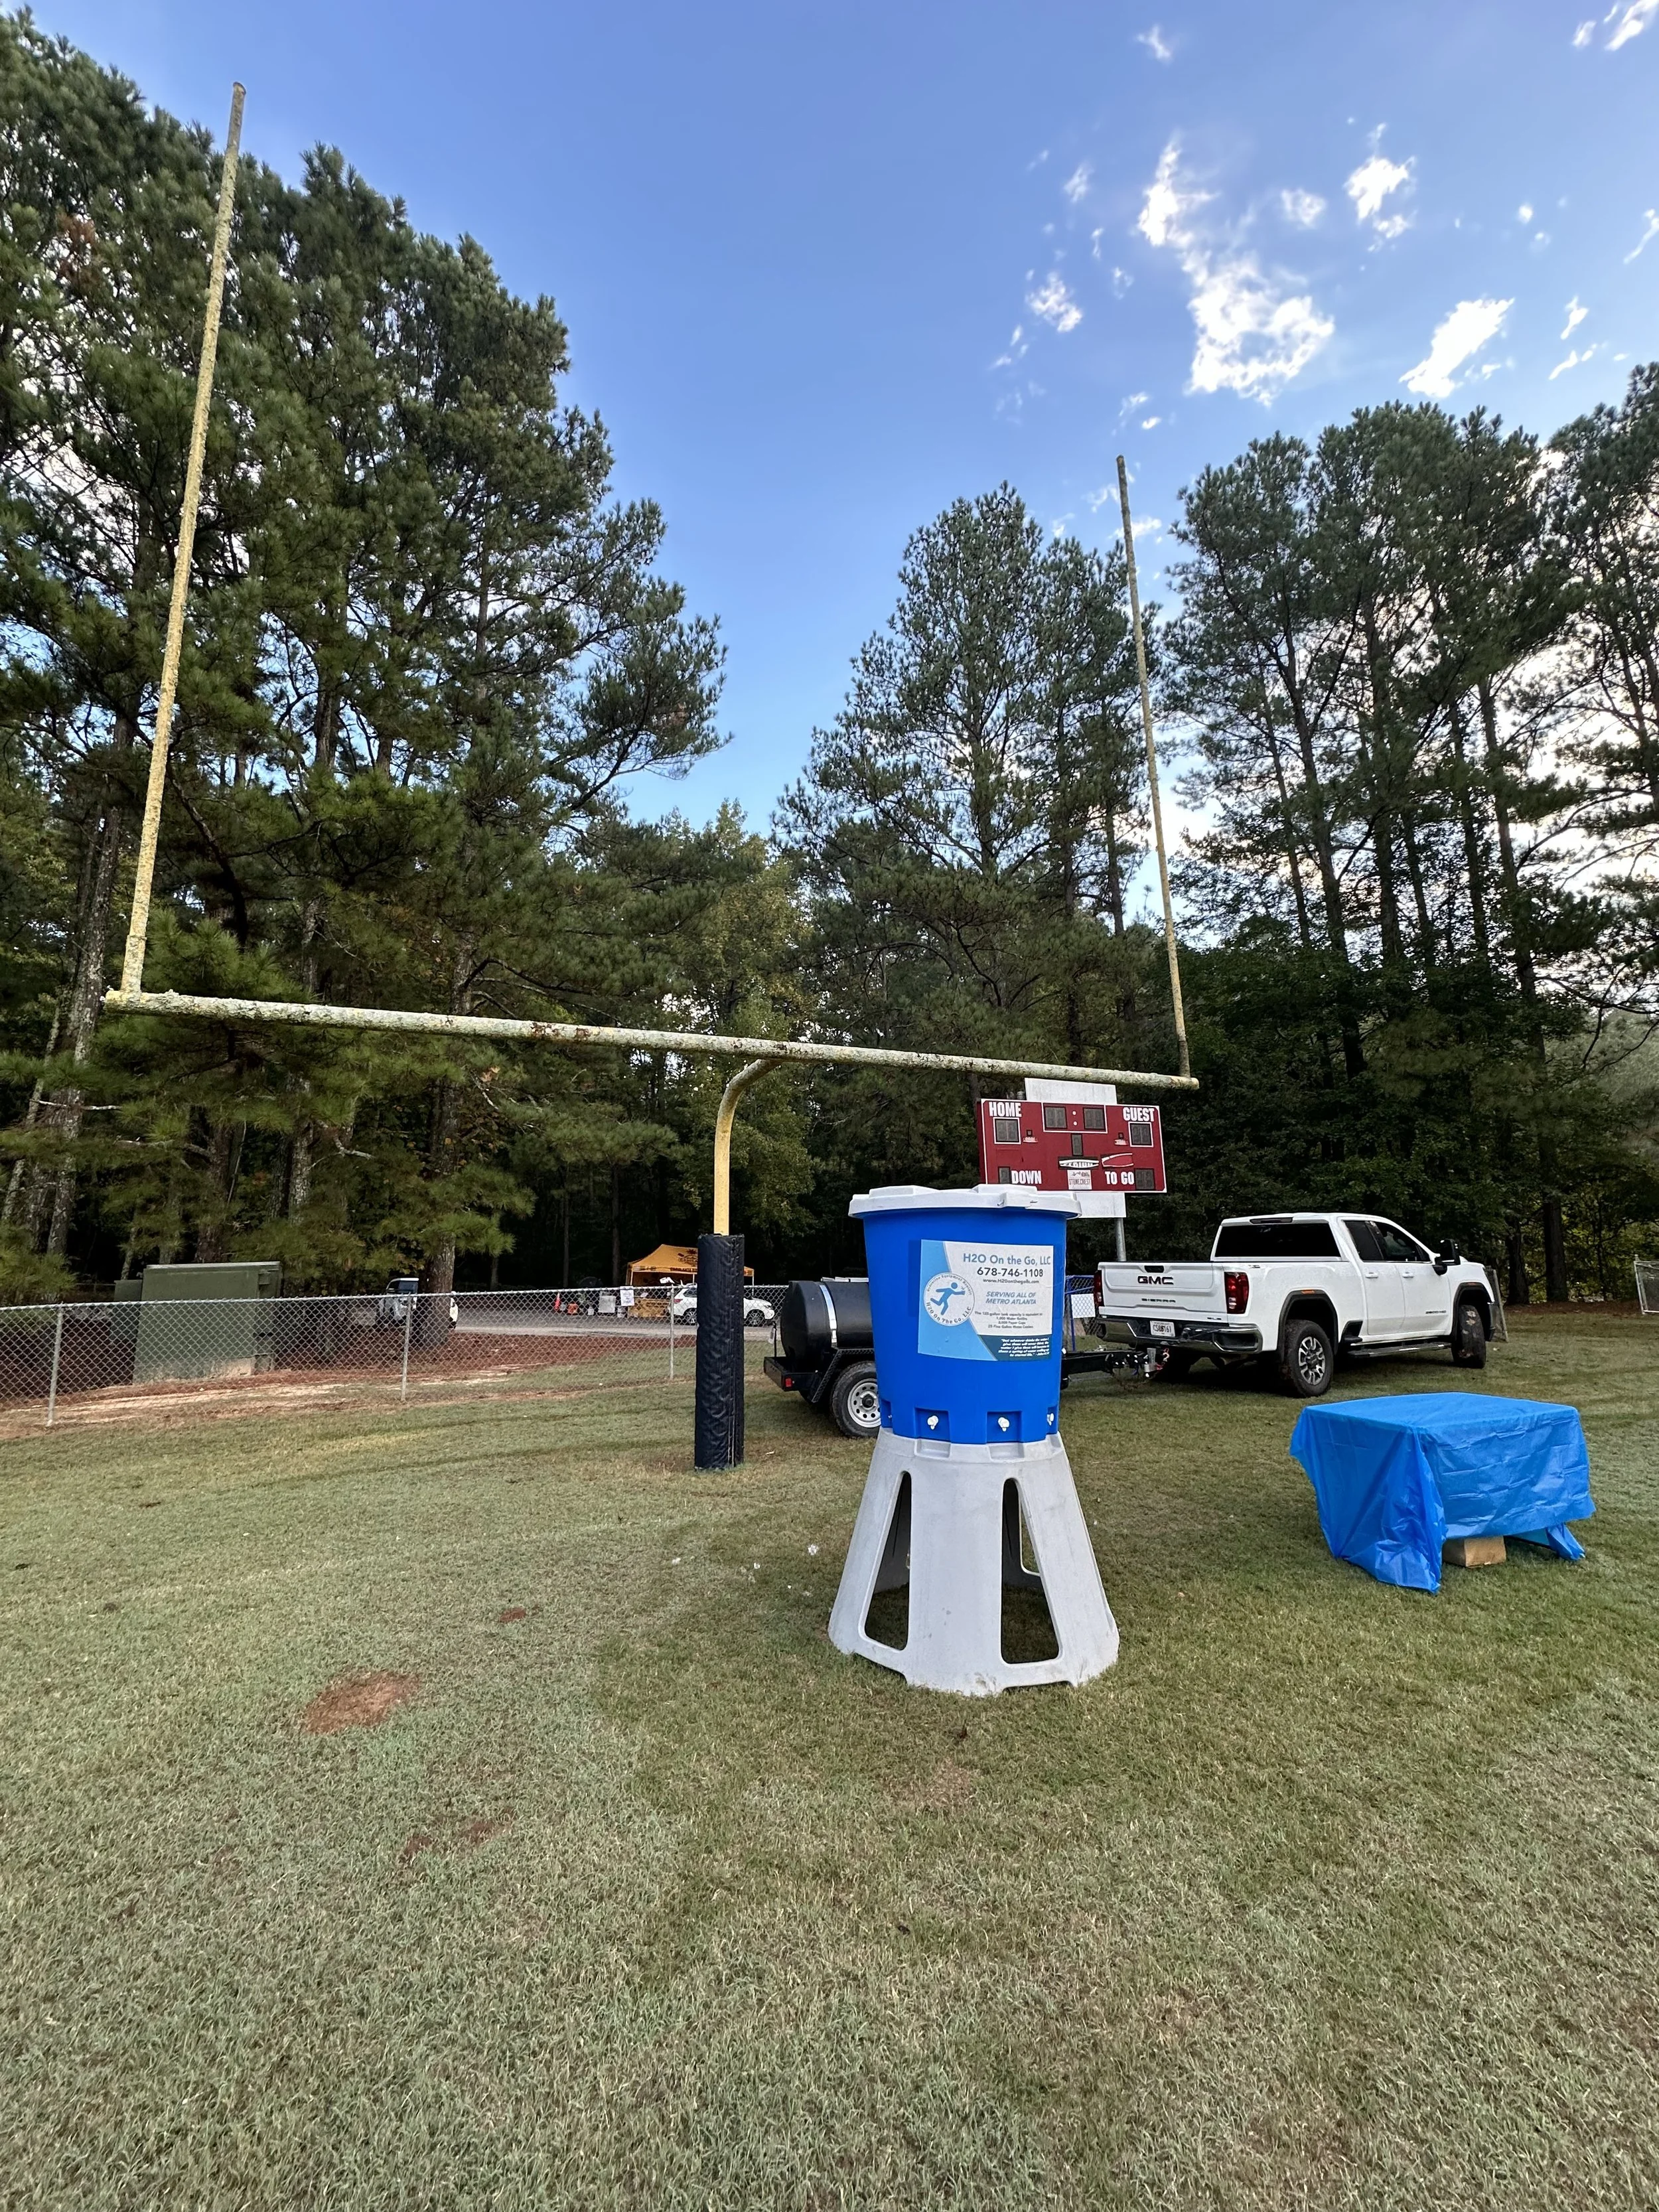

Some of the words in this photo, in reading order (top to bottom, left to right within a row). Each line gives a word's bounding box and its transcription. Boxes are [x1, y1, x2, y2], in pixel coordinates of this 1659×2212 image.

[989, 1102, 1022, 1117] HOME
[1123, 1107, 1155, 1122] GUEST
[1011, 1170, 1042, 1184] DOWN
[1105, 1171, 1118, 1185] TO
[1121, 1171, 1135, 1185] GO
[963, 1253, 986, 1264] H2O
[989, 1254, 1004, 1264] On
[1007, 1255, 1022, 1265] the
[1024, 1256, 1038, 1266] Go,
[1039, 1256, 1051, 1265] LLC
[977, 1267, 1043, 1278] 678-746-1108
[1137, 1276, 1174, 1285] GMC
